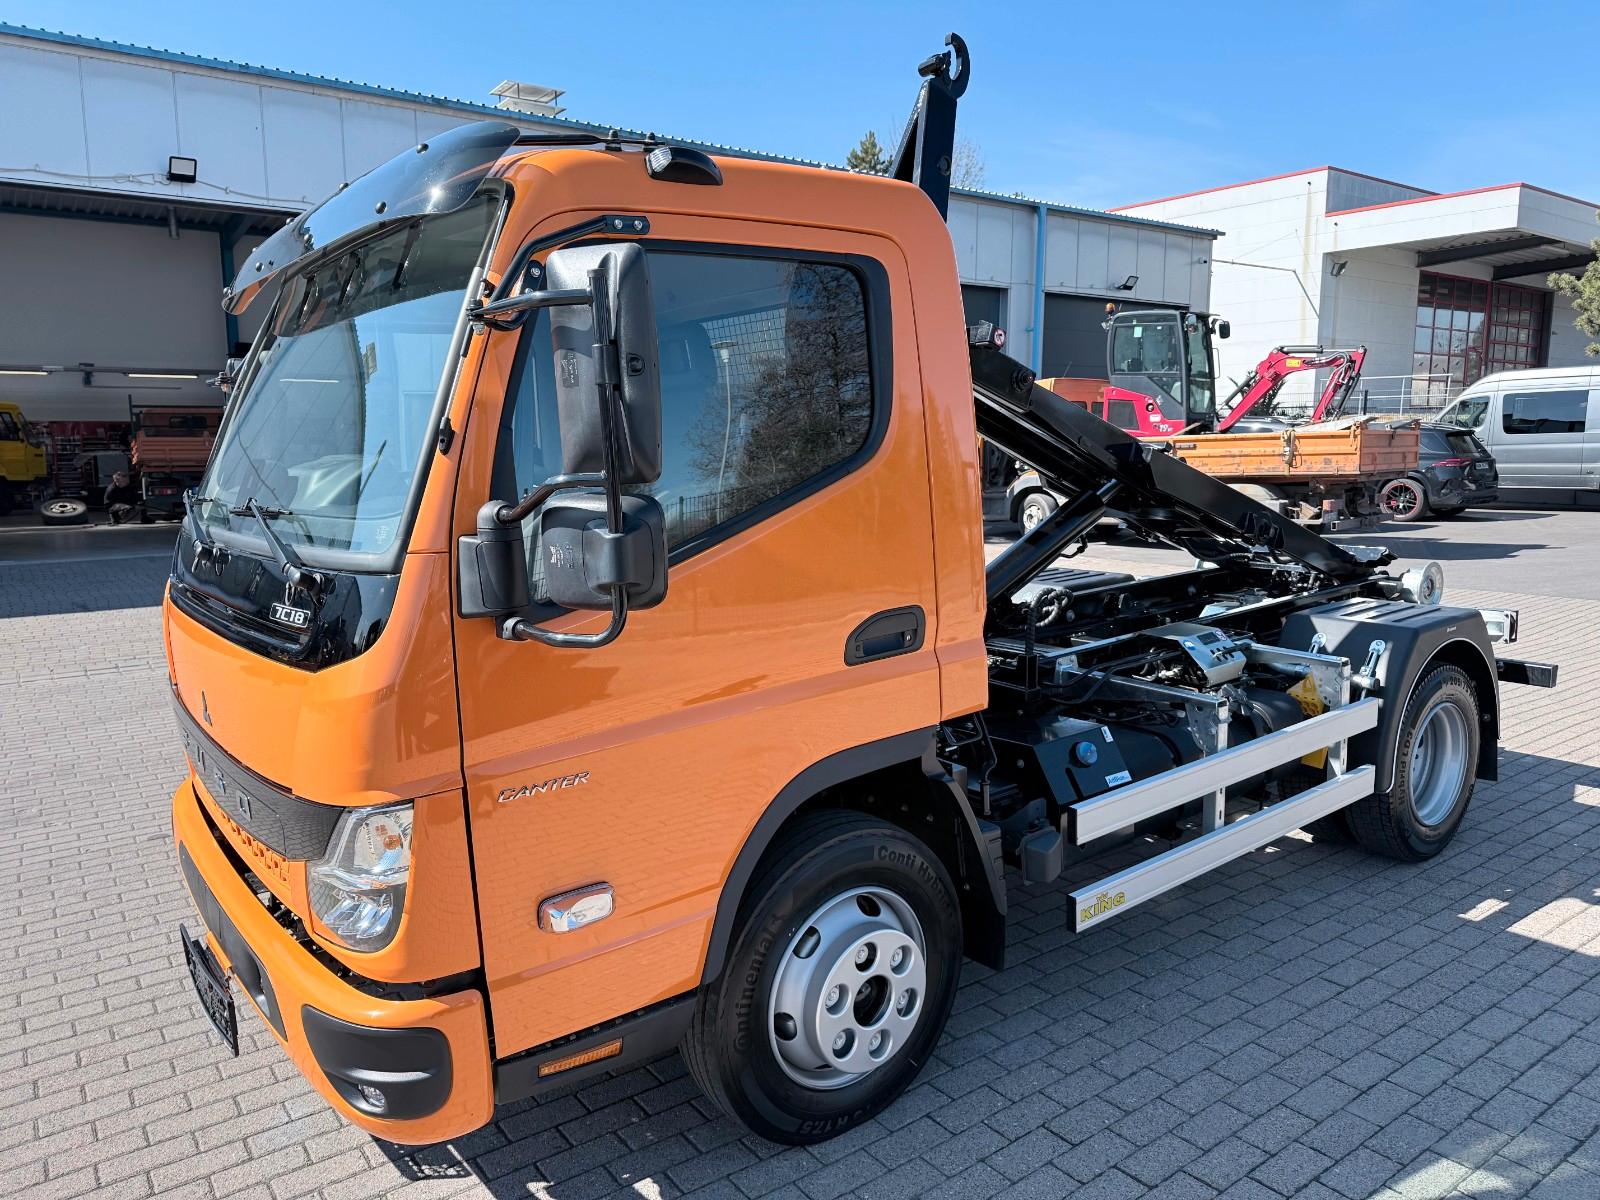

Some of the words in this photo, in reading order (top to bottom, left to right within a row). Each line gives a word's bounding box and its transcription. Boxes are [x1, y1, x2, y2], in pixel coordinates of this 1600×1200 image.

[275, 606, 305, 624] 7C18
[497, 771, 590, 803] CANTER
[1398, 760, 1407, 805] Hybrid
[878, 845, 917, 869] Conti
[1080, 891, 1126, 922] KING
